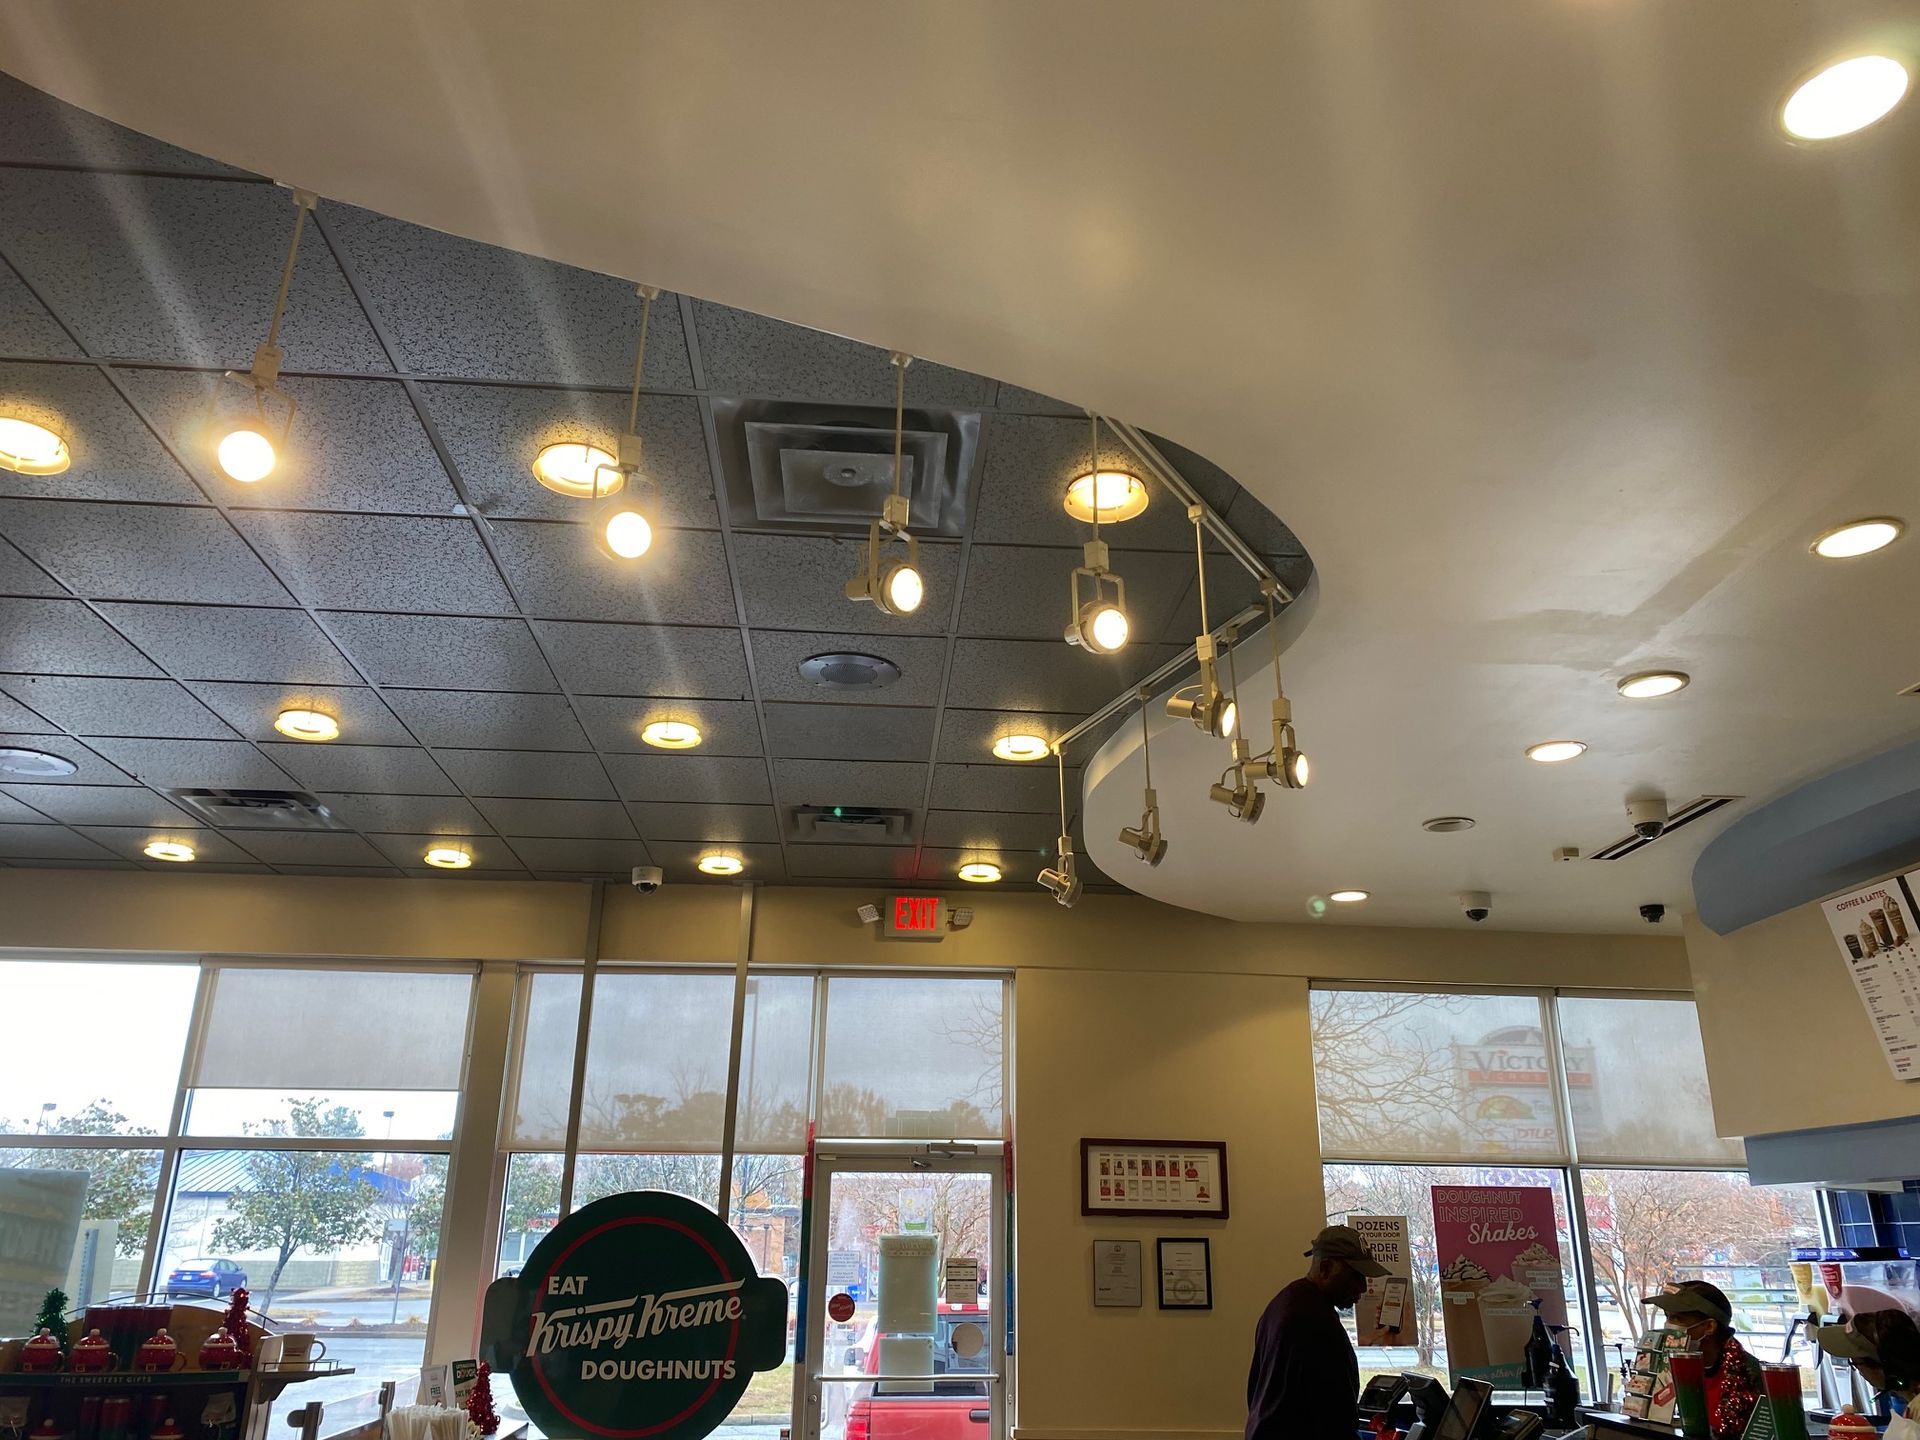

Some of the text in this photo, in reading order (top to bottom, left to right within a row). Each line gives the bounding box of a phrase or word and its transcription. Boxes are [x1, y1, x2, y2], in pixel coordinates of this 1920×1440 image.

[1837, 898, 1860, 911] COFFEE
[1866, 889, 1887, 902] LATTES
[895, 897, 939, 930] EXIT
[1469, 1051, 1585, 1078] VICTOY
[1436, 1189, 1522, 1205] DOUGHNUT
[1439, 1206, 1524, 1223] INSPIRED
[1356, 1221, 1400, 1231] DOZENS
[1467, 1220, 1539, 1245] Shakes
[1370, 1243, 1398, 1252] RDER
[1374, 1253, 1399, 1262] LINE
[547, 1276, 588, 1296] EAT
[526, 1277, 746, 1358] Krispy Kreme
[60, 1376, 76, 1384] THE
[80, 1376, 124, 1384] SWEETEST
[581, 1359, 737, 1381] DOUGHNUTS
